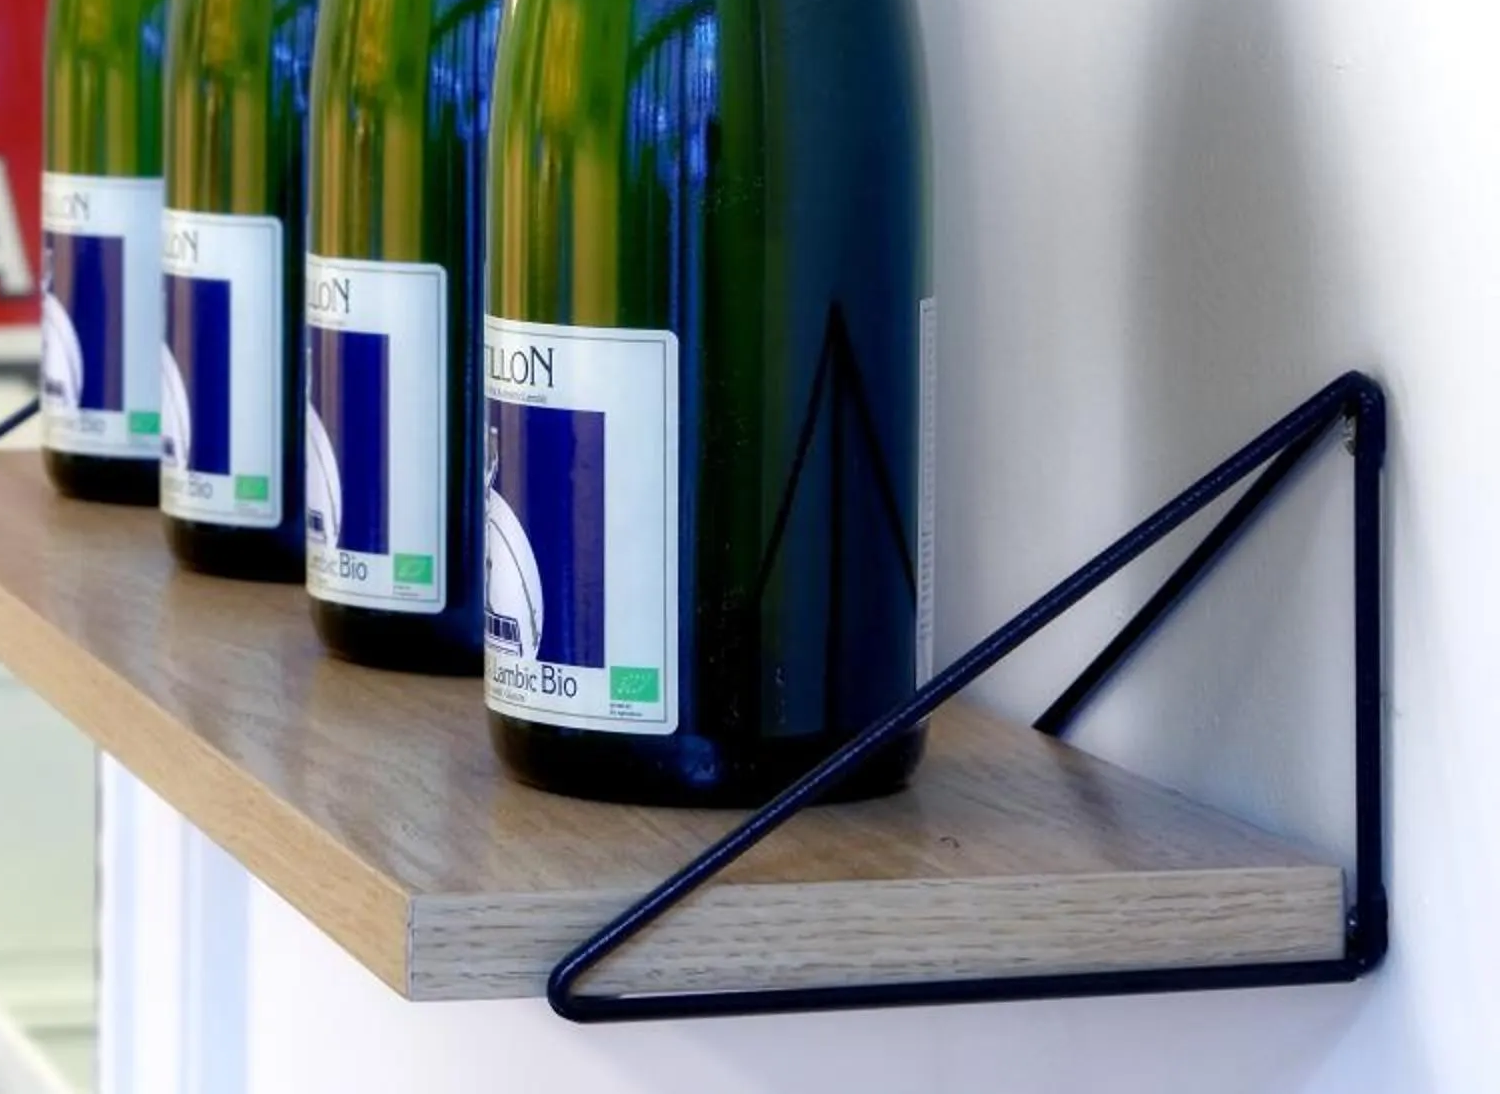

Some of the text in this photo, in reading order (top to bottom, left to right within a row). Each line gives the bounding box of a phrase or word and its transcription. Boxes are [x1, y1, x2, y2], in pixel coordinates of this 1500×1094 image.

[340, 551, 368, 581] Bio
[493, 657, 537, 693] Lambic
[541, 663, 578, 698] Bio
